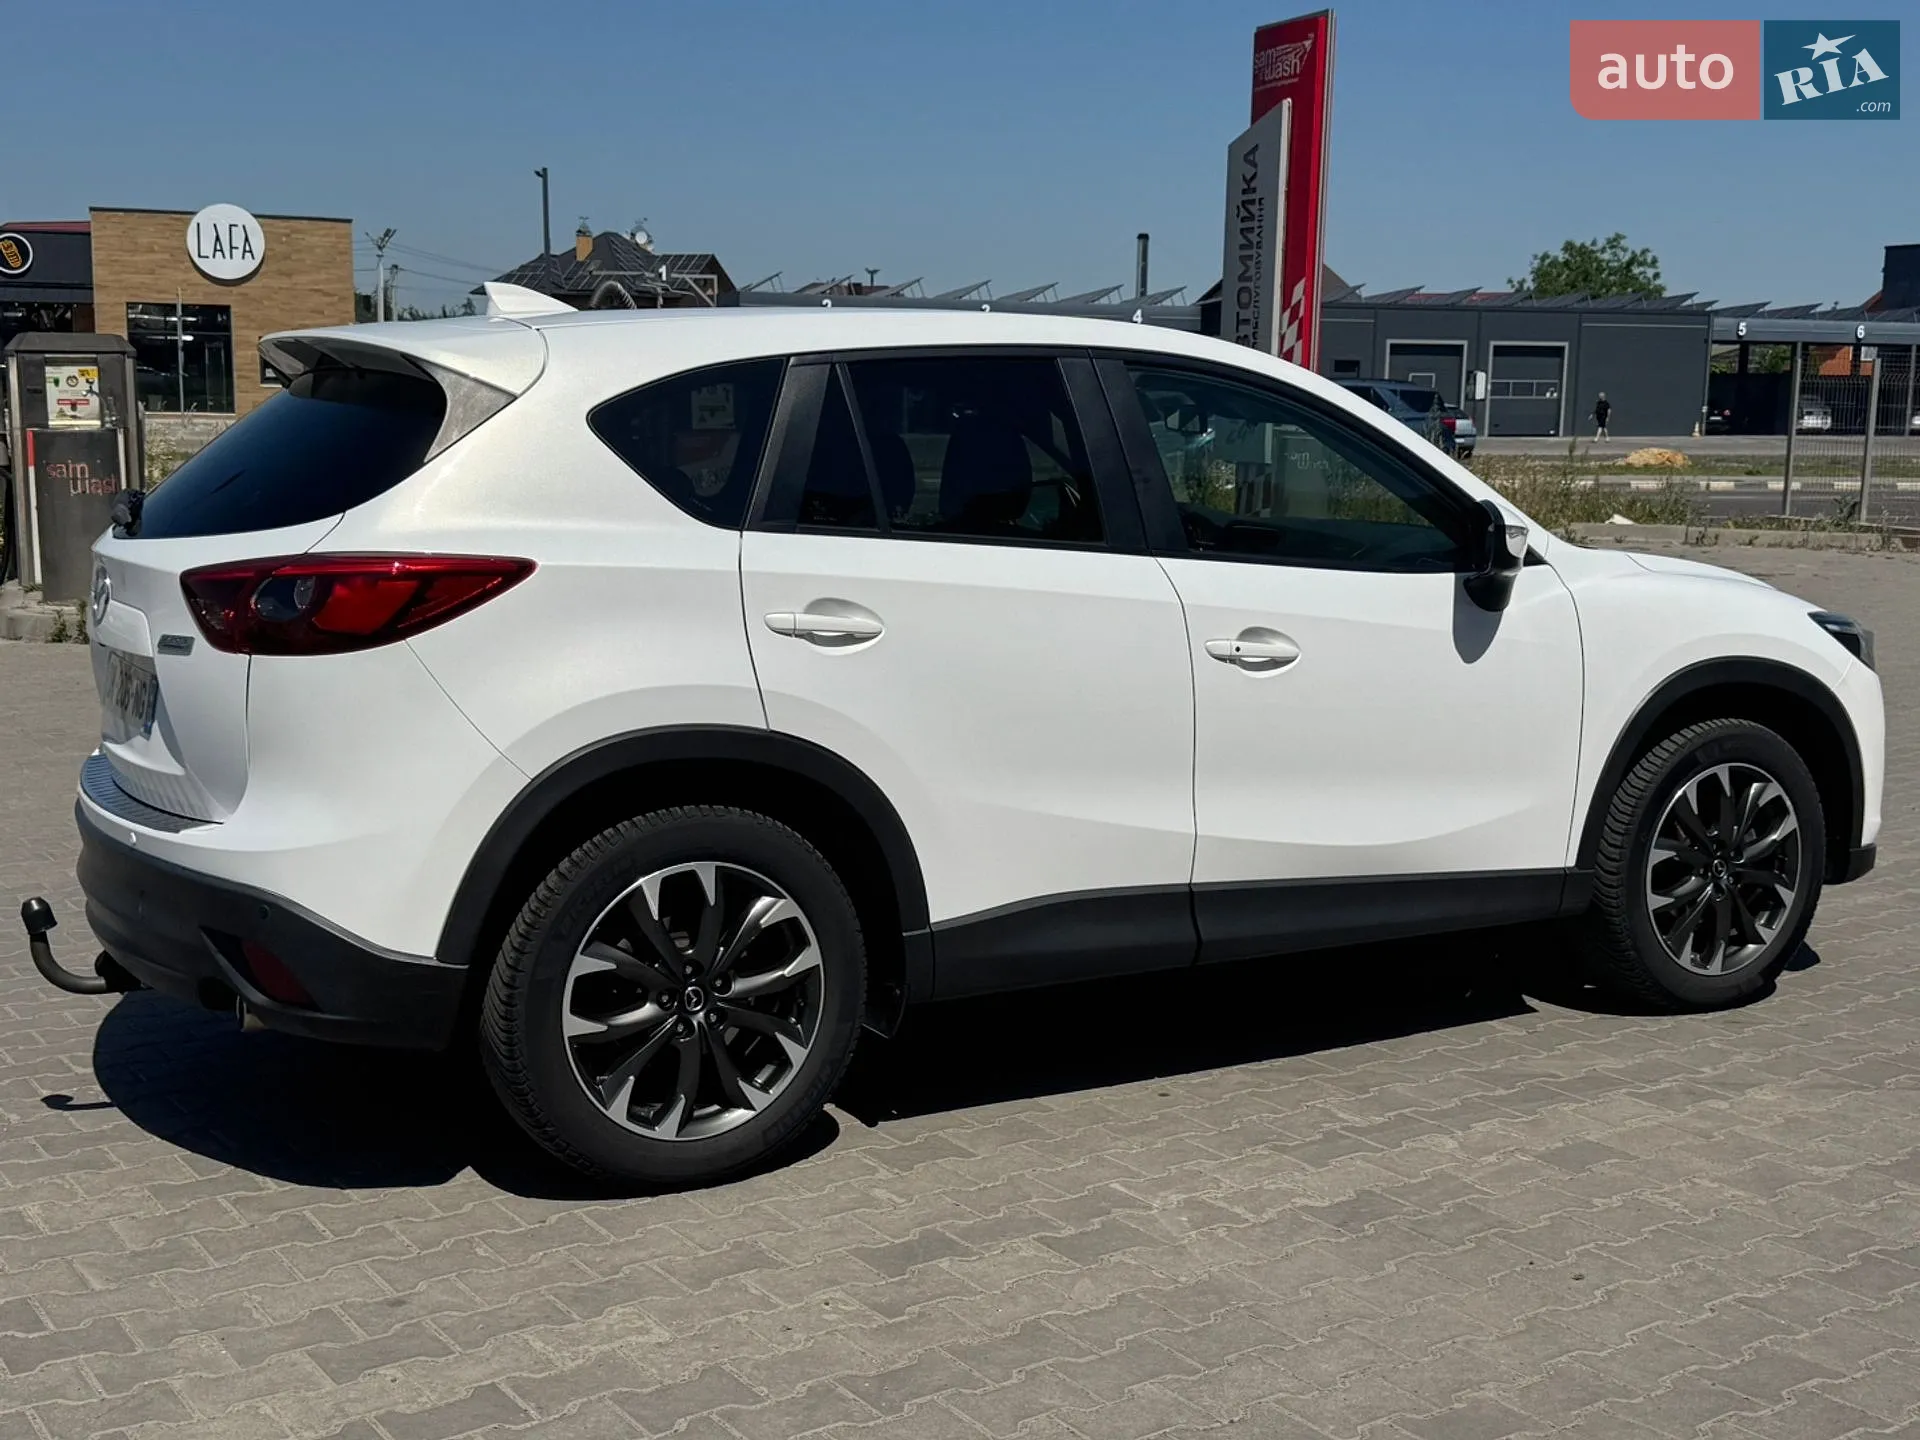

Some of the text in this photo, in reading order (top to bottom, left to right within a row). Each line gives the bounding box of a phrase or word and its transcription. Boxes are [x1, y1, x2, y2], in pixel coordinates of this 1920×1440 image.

[196, 222, 256, 260] LAFA
[1235, 143, 1260, 348] ВТОМИЙКА
[1132, 308, 1143, 324] 4
[1737, 321, 1748, 336] 5
[1856, 324, 1866, 339] 6
